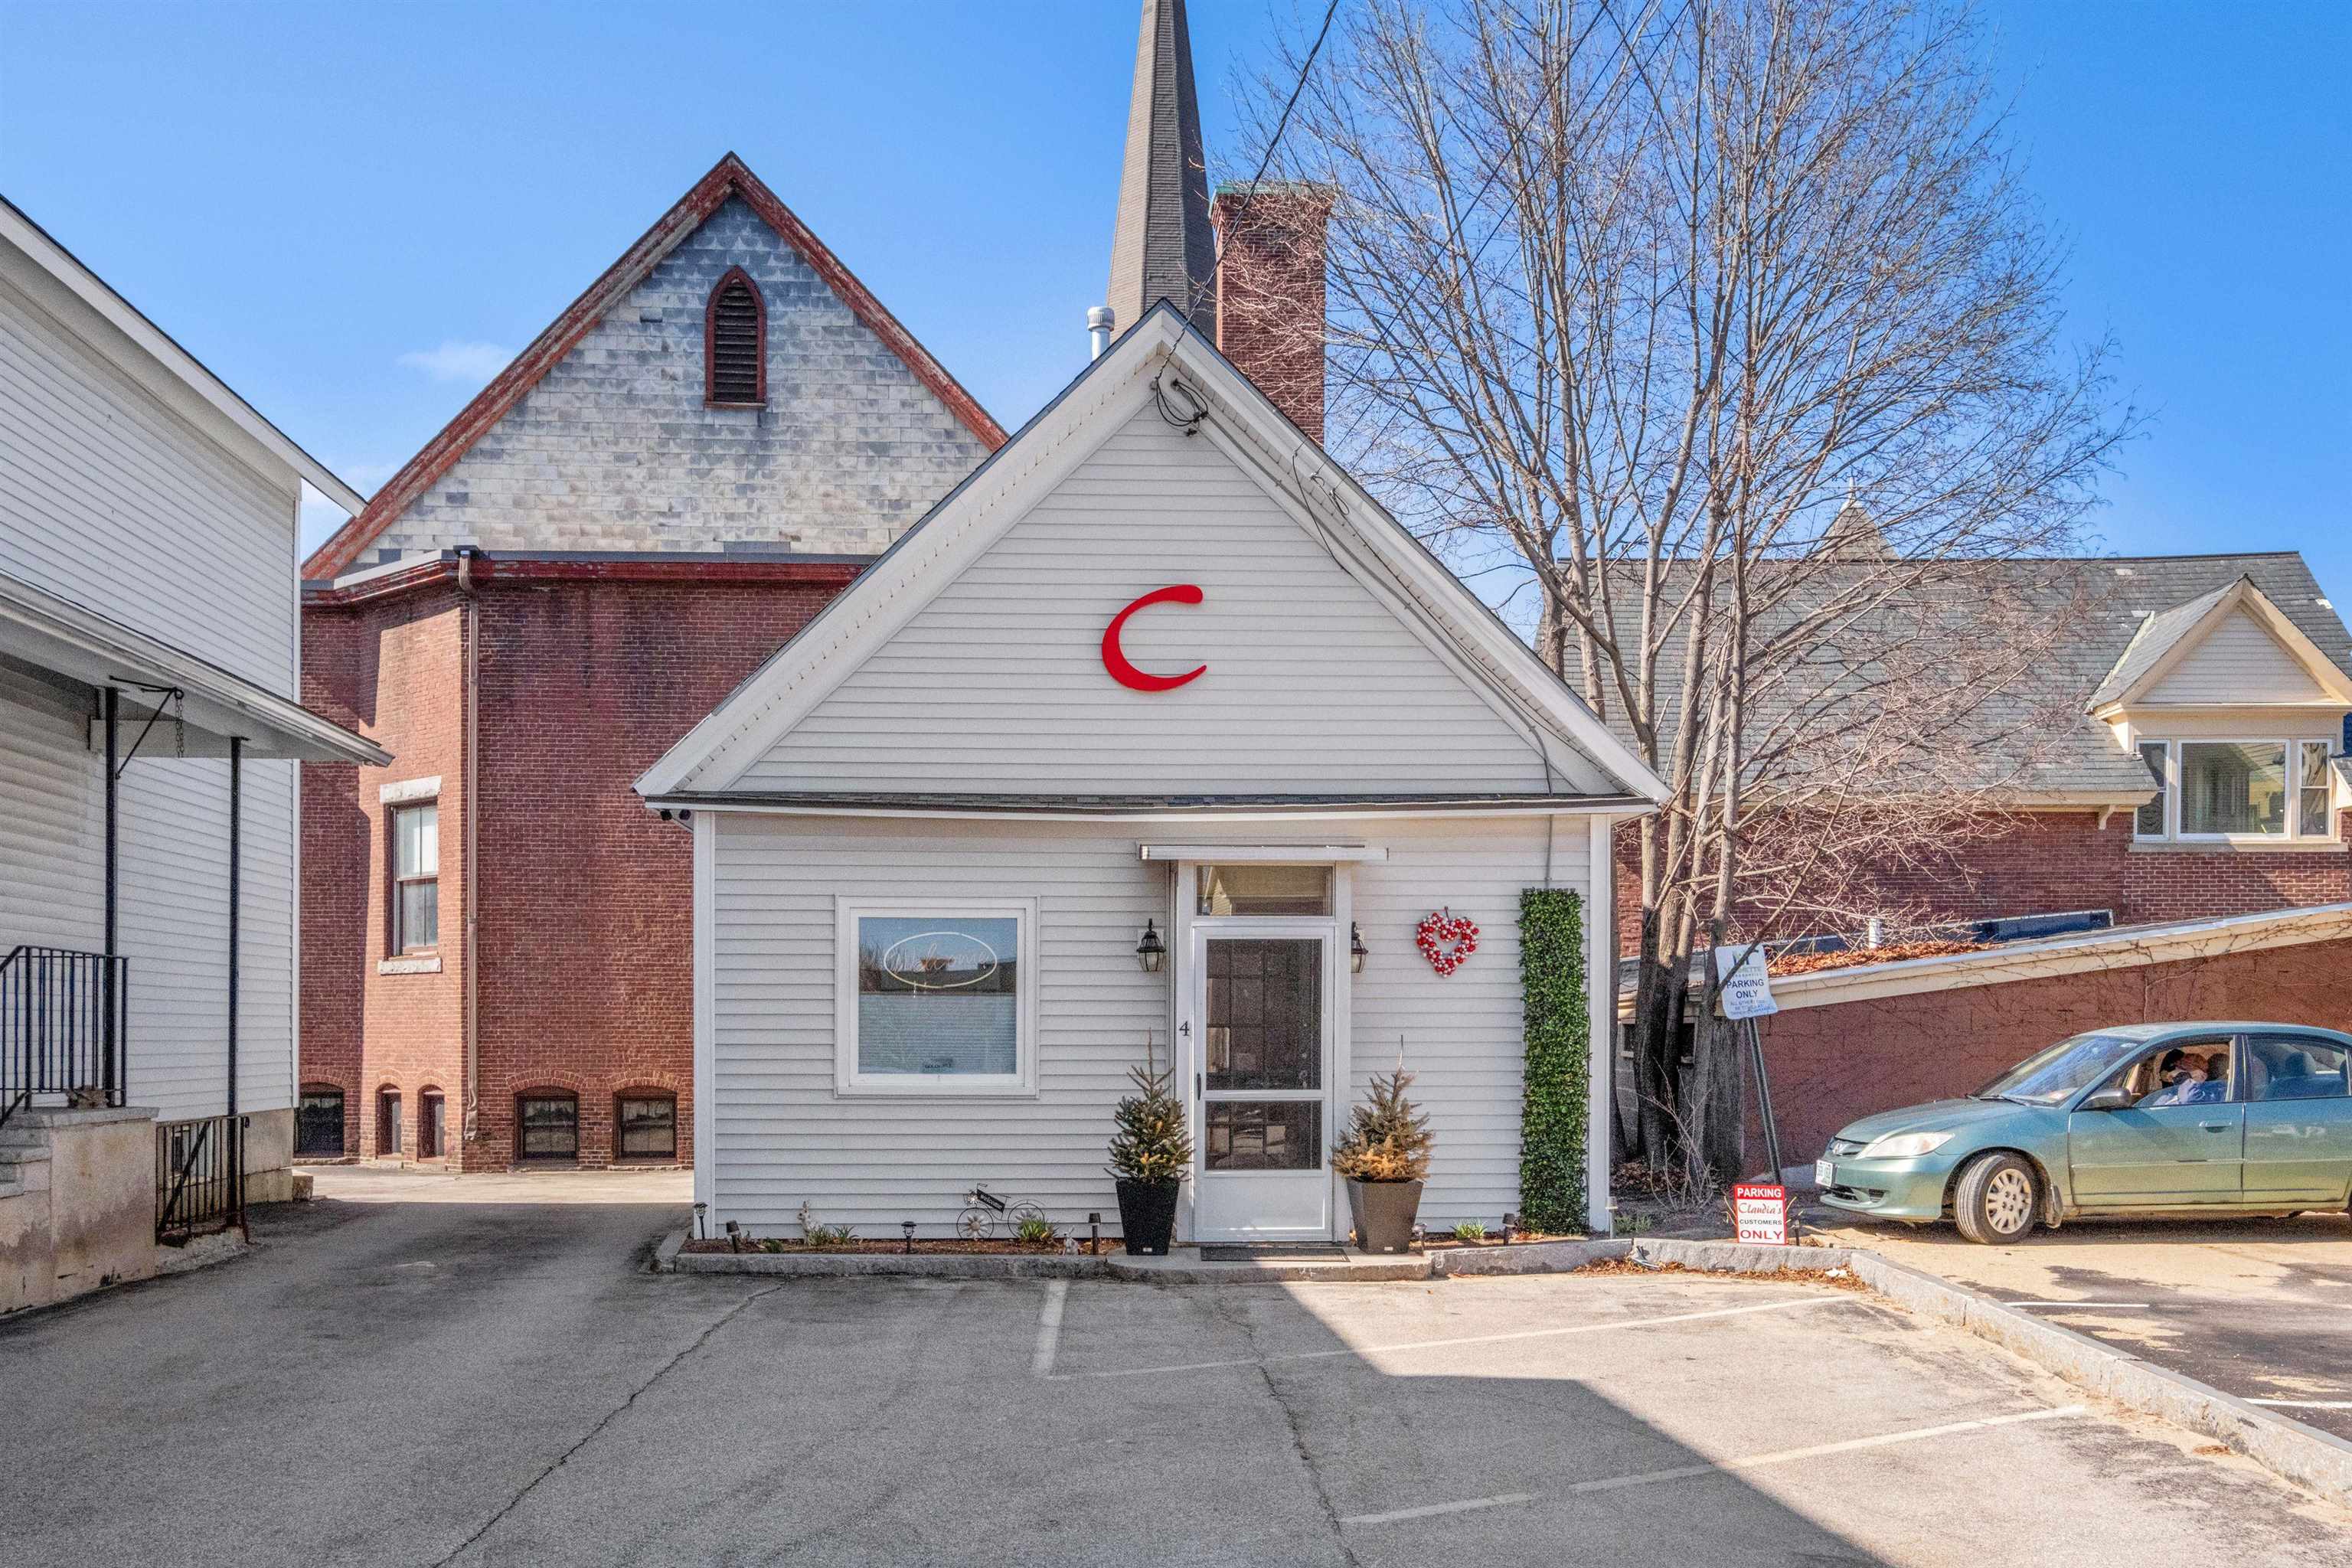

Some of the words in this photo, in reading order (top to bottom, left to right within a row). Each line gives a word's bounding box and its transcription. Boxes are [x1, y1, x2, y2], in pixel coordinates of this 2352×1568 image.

[1102, 584, 1207, 691] C
[1727, 979, 1764, 988] PARKING
[1736, 990, 1757, 998] ONLY
[1179, 1021, 1189, 1036] 4
[1737, 1187, 1782, 1197] PARKING
[980, 1194, 1002, 1209] welcome
[1739, 1202, 1782, 1214] Claudia's
[1740, 1230, 1782, 1240] ONLY
